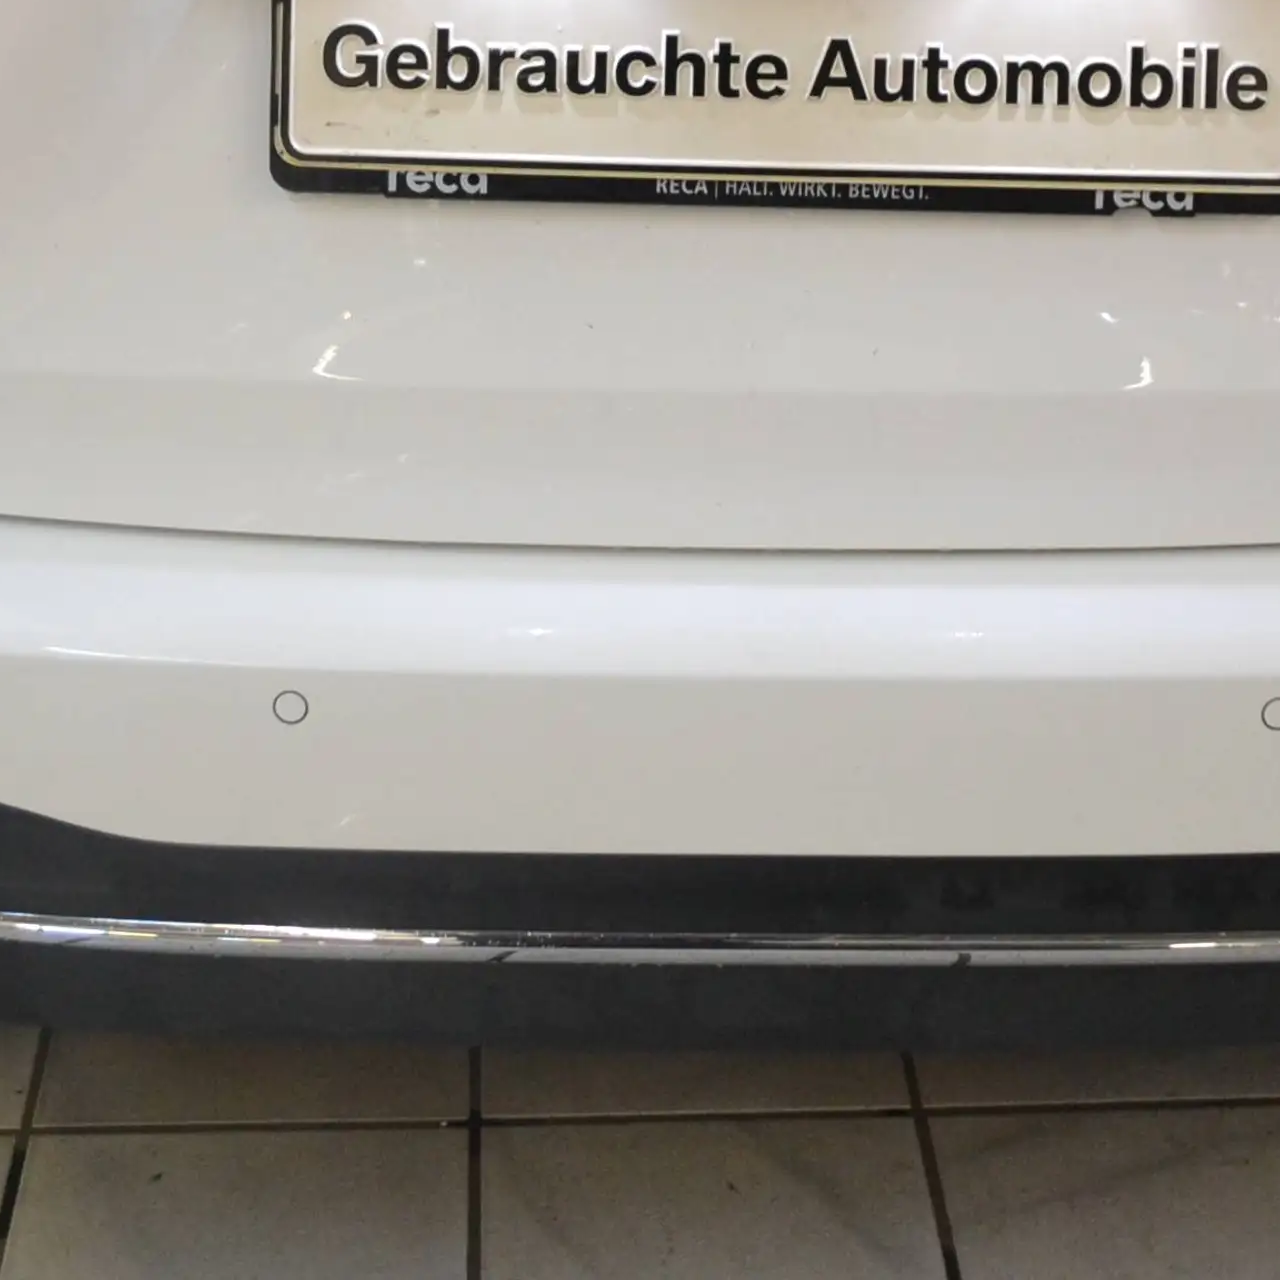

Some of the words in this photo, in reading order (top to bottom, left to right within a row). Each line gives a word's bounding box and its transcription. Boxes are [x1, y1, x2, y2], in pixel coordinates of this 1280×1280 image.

[321, 22, 790, 101] Gebrauchte
[807, 37, 1270, 112] Automobile
[387, 169, 488, 194] reca
[655, 178, 708, 195] RECA
